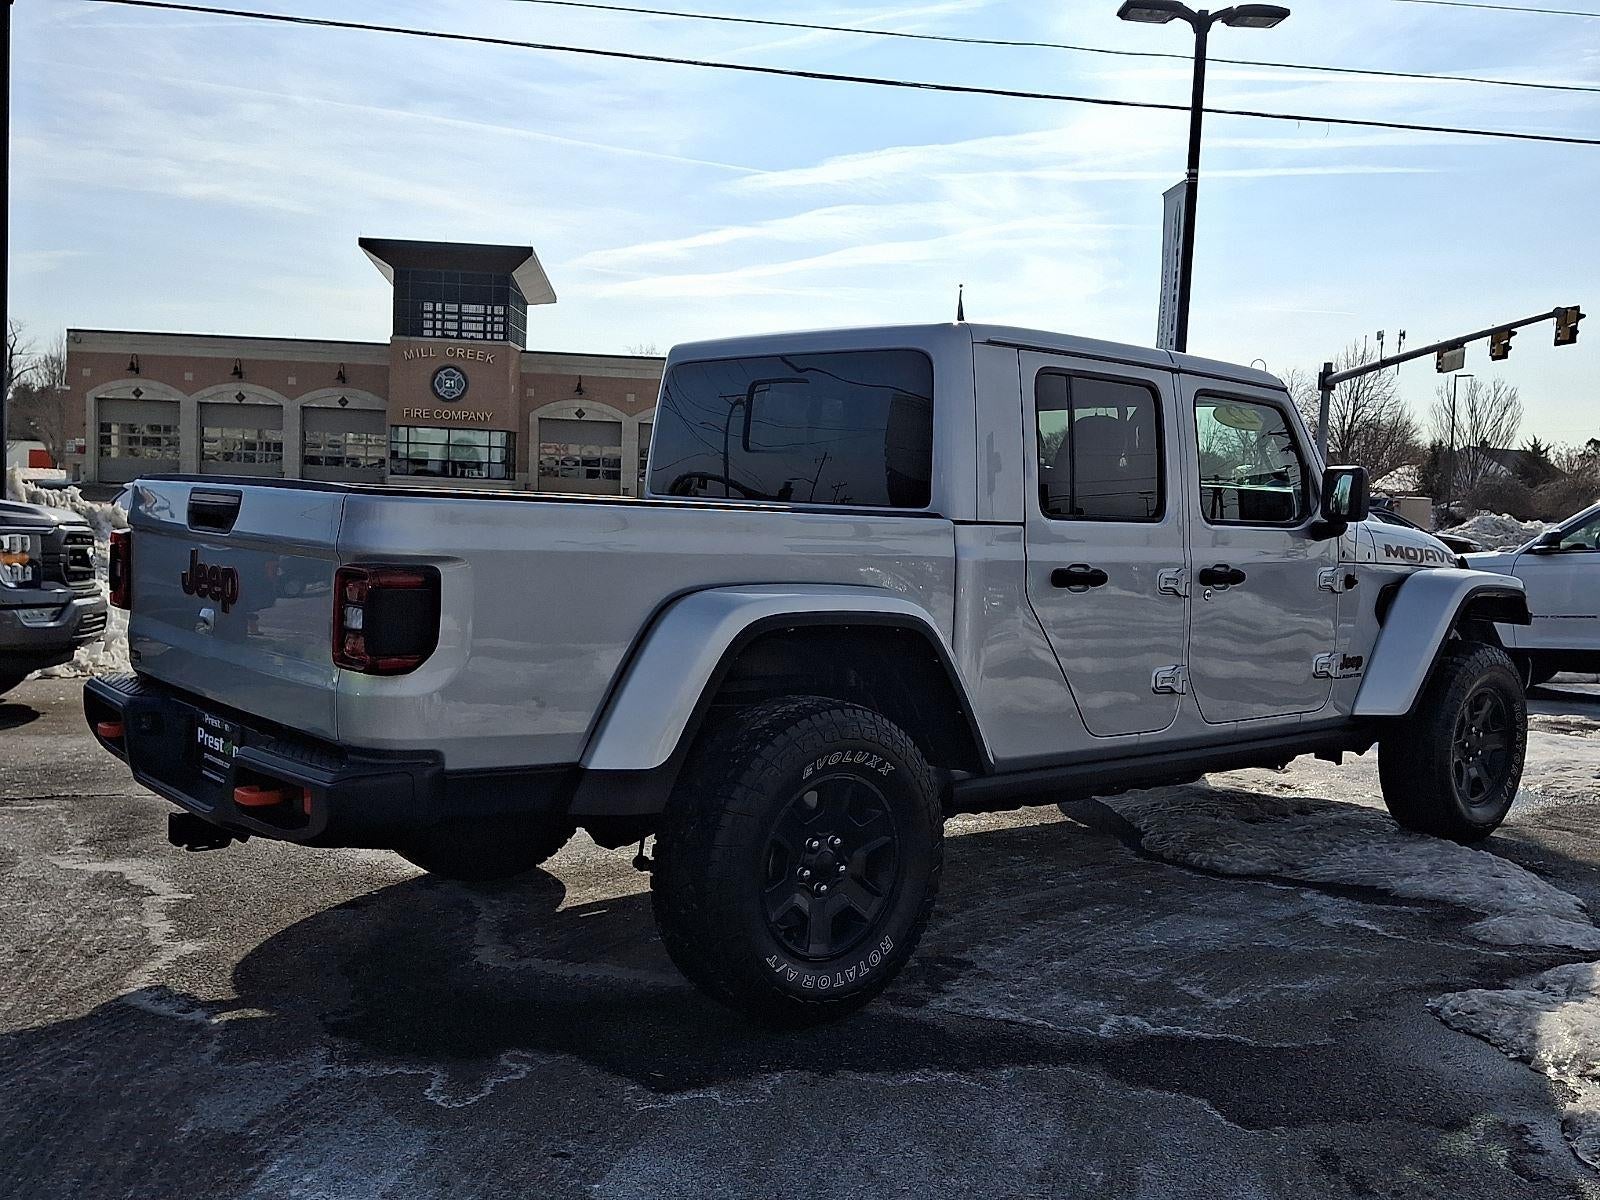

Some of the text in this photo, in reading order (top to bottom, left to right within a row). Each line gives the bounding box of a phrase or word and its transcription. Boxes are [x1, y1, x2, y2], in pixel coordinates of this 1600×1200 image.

[403, 346, 496, 364] MILL CREEK
[445, 379, 455, 388] 21
[403, 407, 493, 421] FIRE COMPANY
[181, 547, 239, 614] Jeep
[1340, 653, 1364, 671] Jeep
[803, 750, 895, 779] EVOLUXX
[766, 935, 893, 989] ROTATOR A/T
